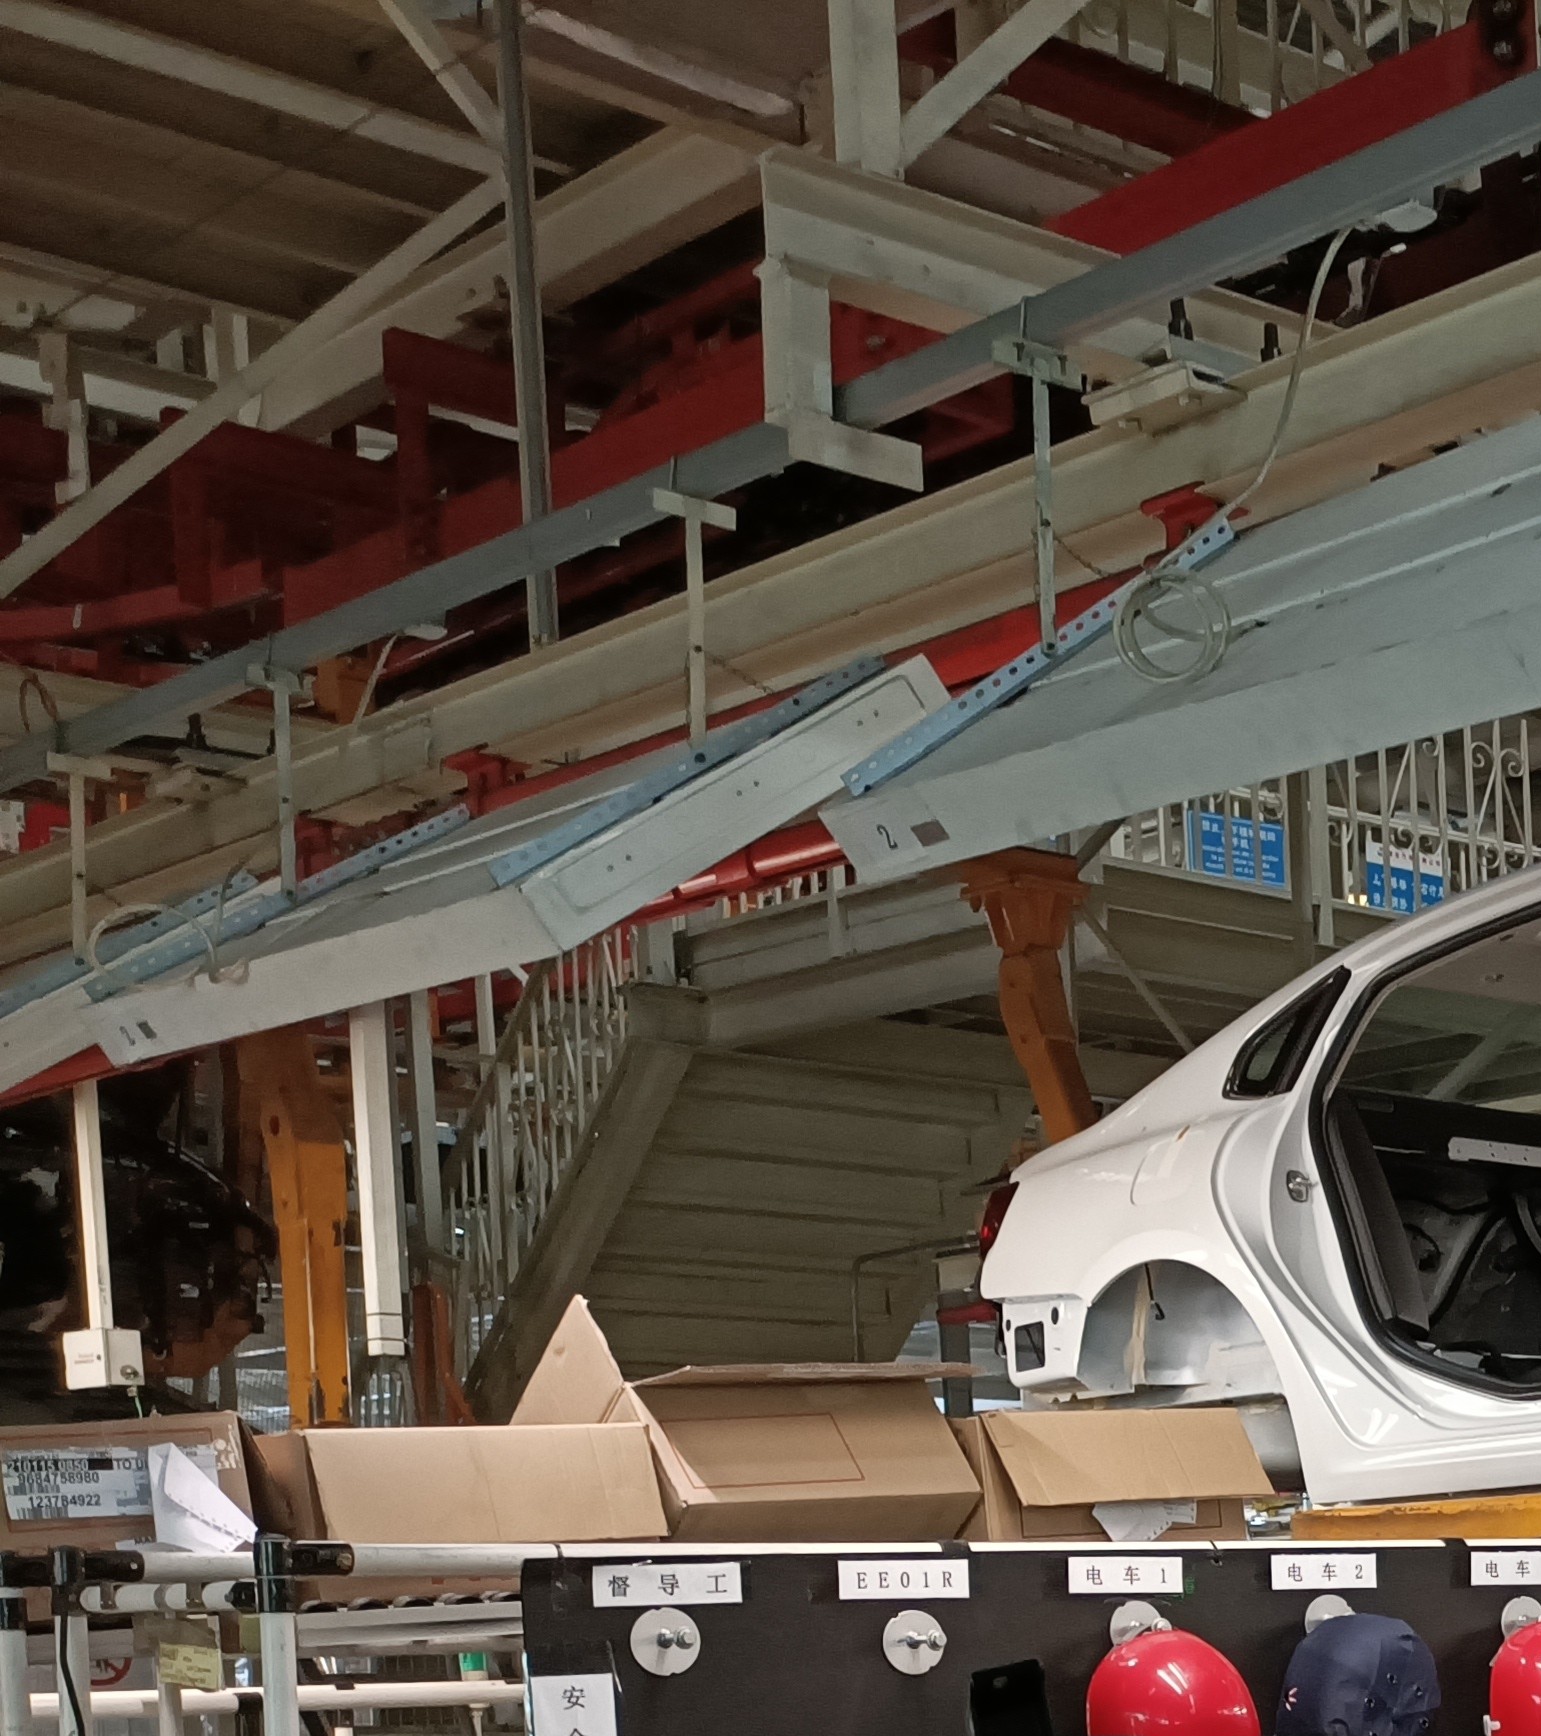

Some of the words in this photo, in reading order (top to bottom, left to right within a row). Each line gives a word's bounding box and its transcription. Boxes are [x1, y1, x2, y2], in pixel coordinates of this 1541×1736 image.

[876, 824, 899, 850] 2
[608, 1573, 728, 1598] 督导工
[856, 1571, 954, 1590] EE01R
